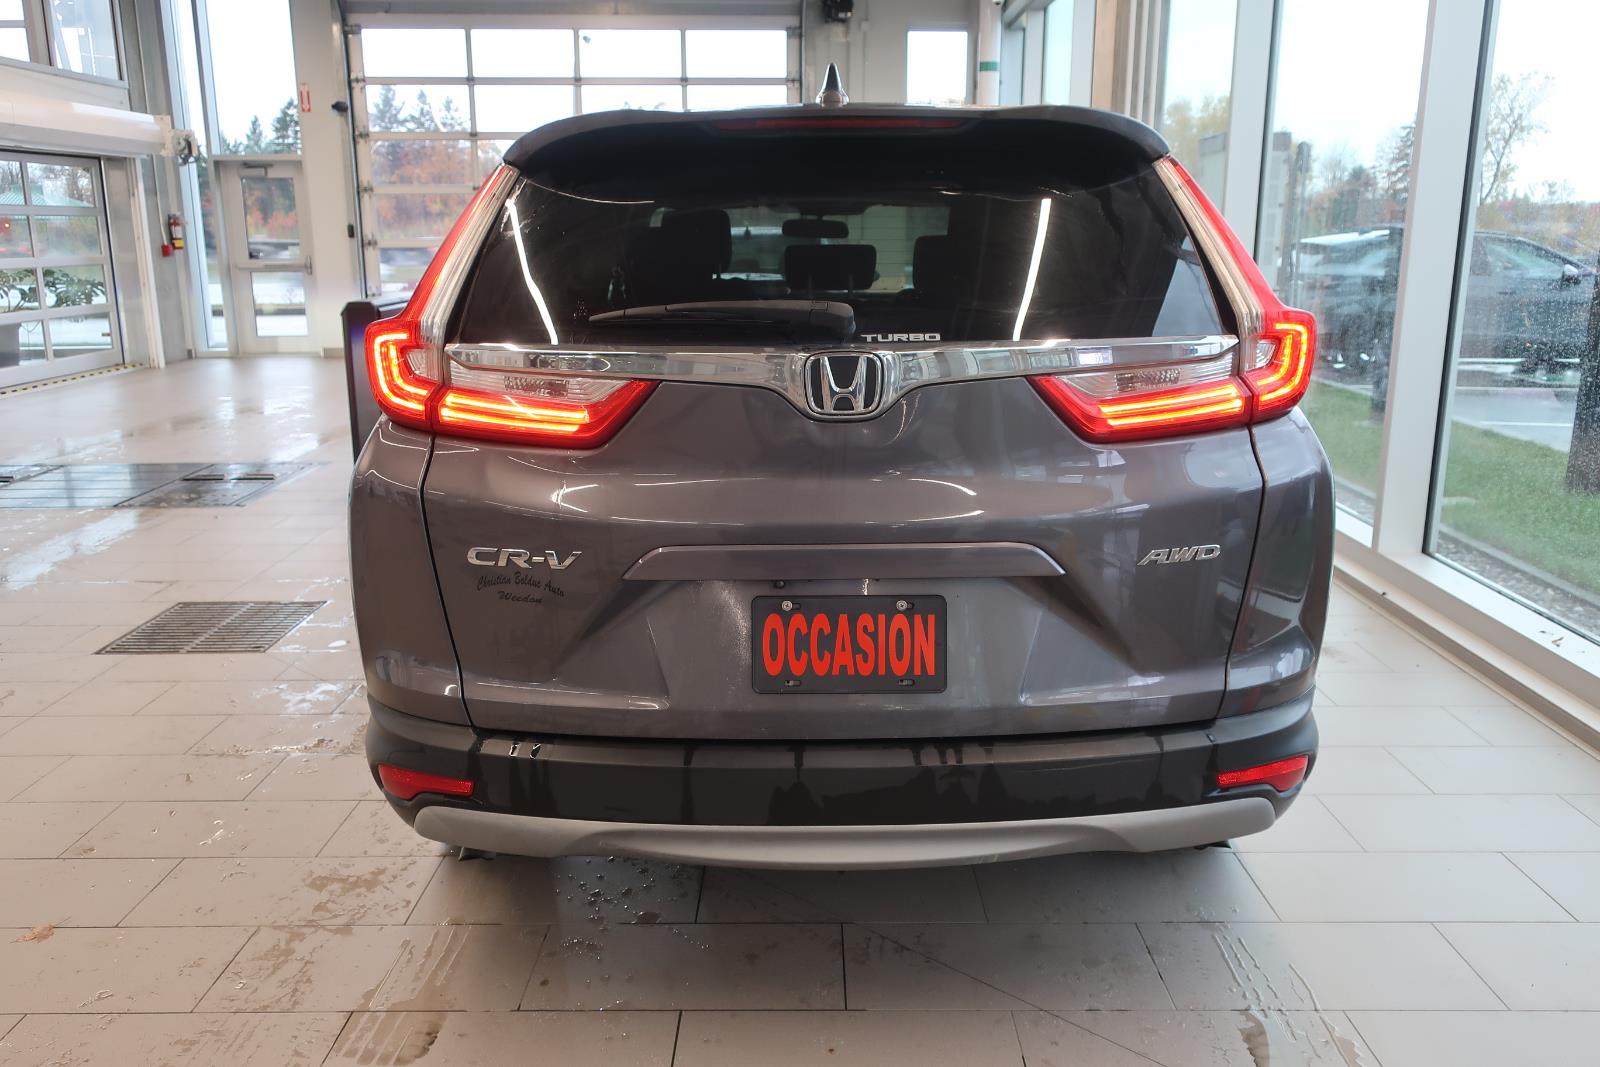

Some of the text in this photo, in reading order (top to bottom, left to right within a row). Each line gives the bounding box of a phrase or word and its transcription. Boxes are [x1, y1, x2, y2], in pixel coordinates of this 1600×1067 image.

[861, 333, 941, 342] TURBO
[466, 547, 582, 569] CR-V
[1136, 544, 1221, 566] AWD
[514, 571, 541, 588] Bolduc
[543, 580, 564, 597] Auto
[497, 590, 542, 603] Weedon
[762, 612, 936, 677] OCCASION
